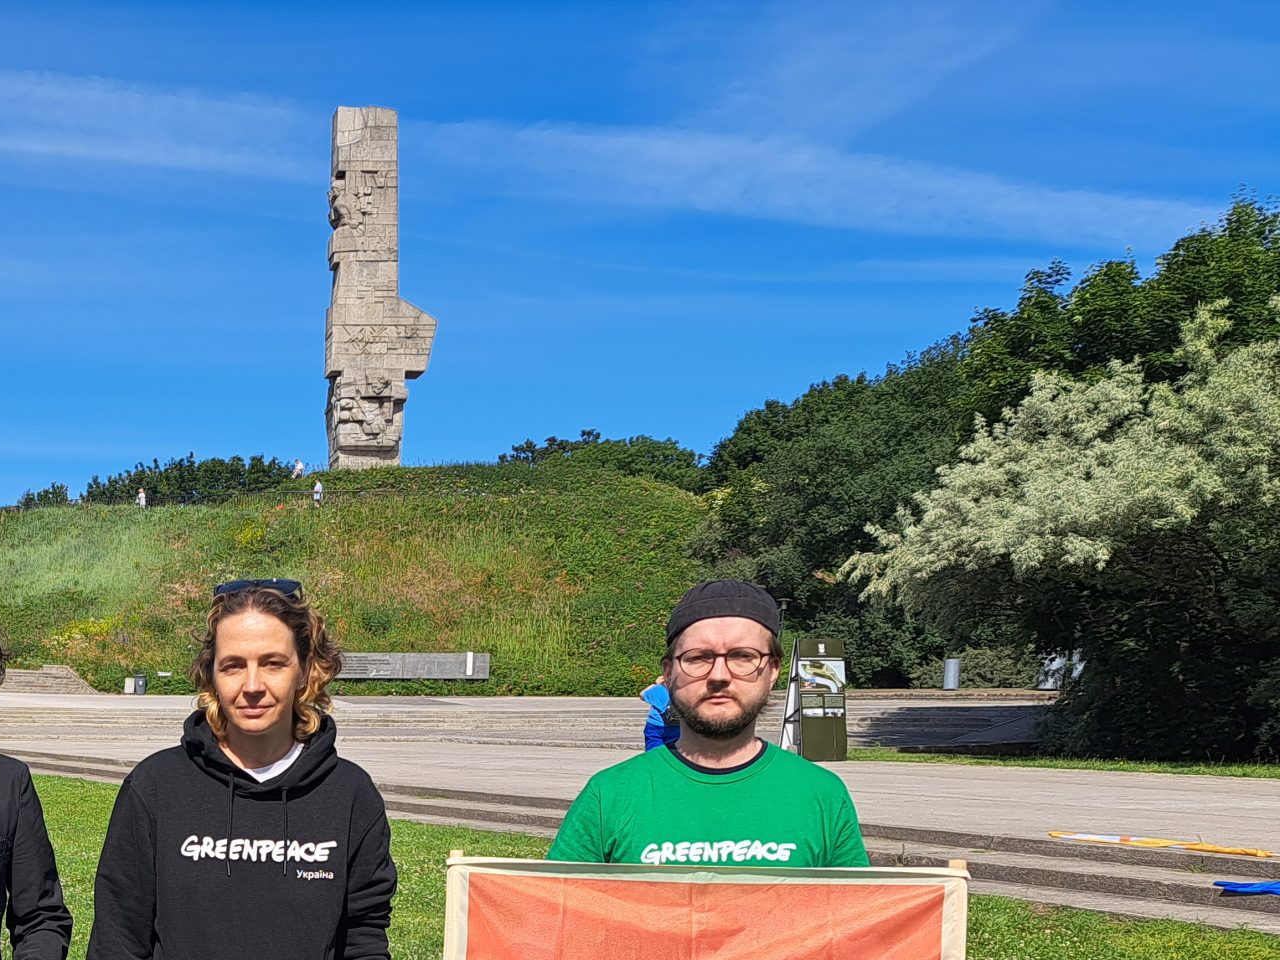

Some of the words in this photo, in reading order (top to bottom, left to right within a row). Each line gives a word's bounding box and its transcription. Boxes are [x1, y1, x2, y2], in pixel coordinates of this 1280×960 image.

[181, 835, 338, 863] GREENPEACE
[640, 840, 797, 865] GREENPEACE
[296, 869, 334, 880] Україна
